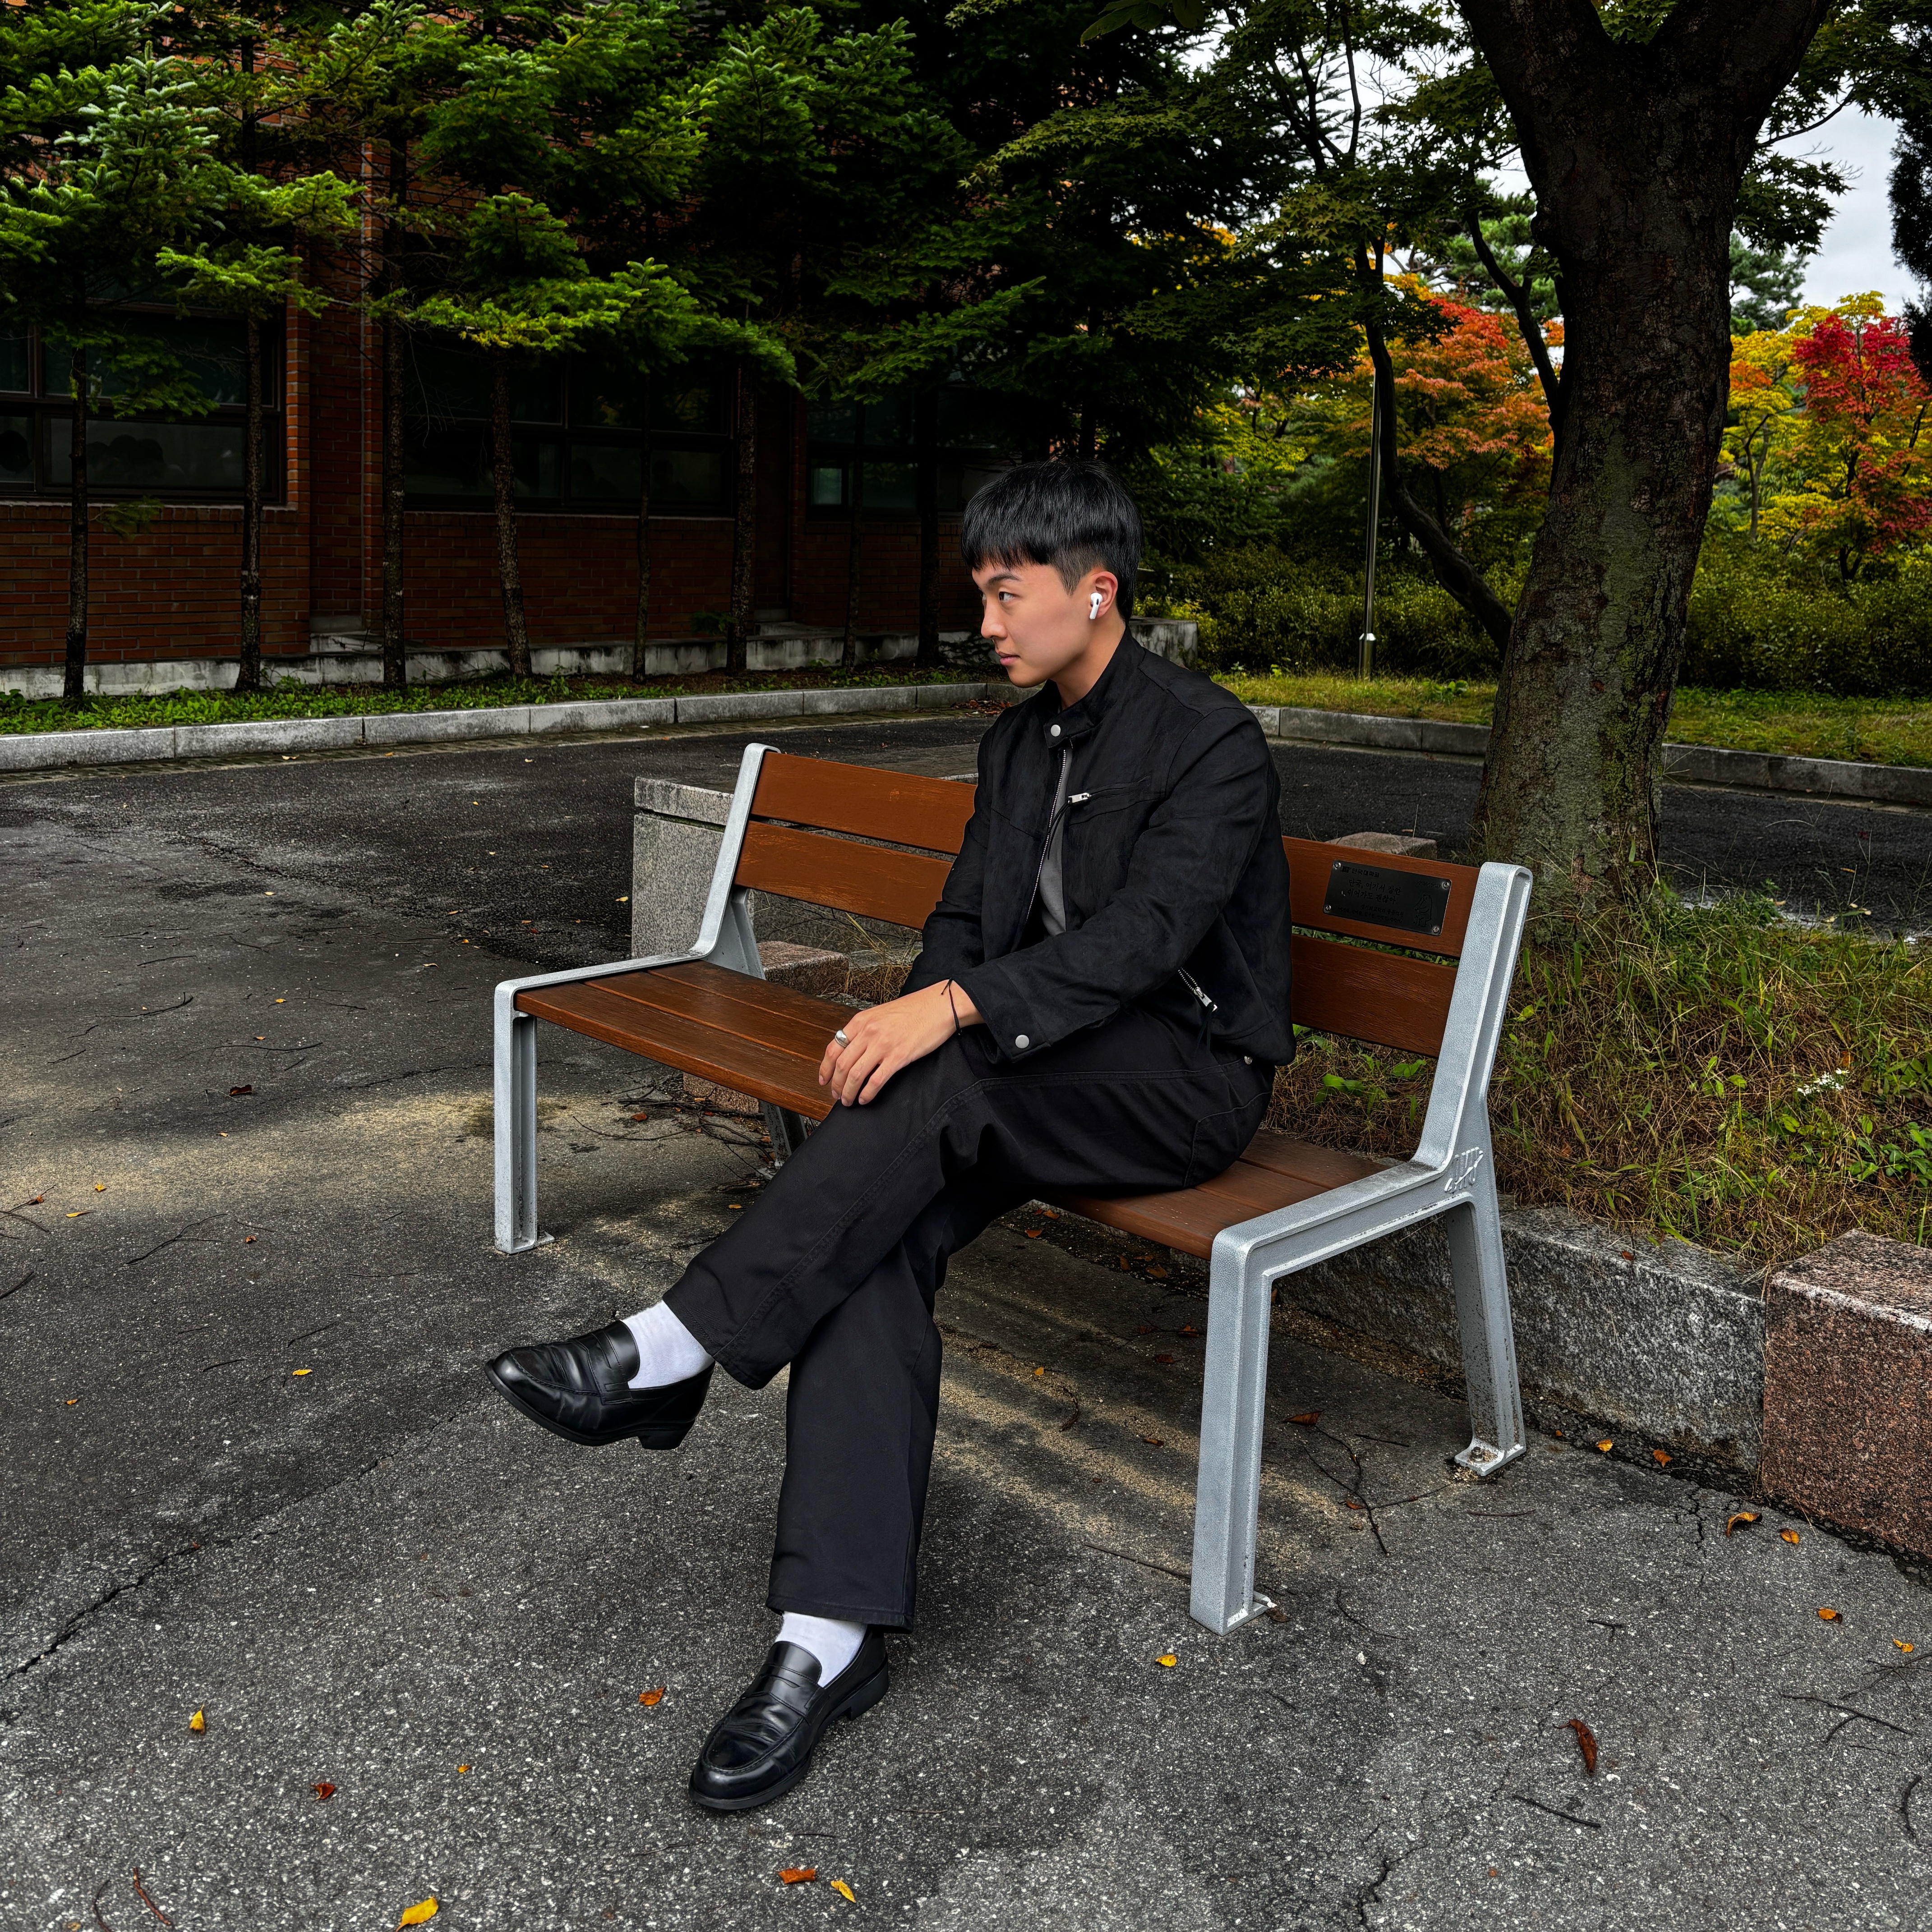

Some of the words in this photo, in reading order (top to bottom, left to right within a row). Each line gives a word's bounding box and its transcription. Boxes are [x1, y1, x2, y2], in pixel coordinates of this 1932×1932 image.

[1352, 868, 1379, 878] 단국대학교
[1349, 878, 1363, 888] 단국,
[1366, 882, 1385, 892] 여기서
[1388, 885, 1402, 895] 잠깐
[1347, 888, 1374, 899] 쉬어가도
